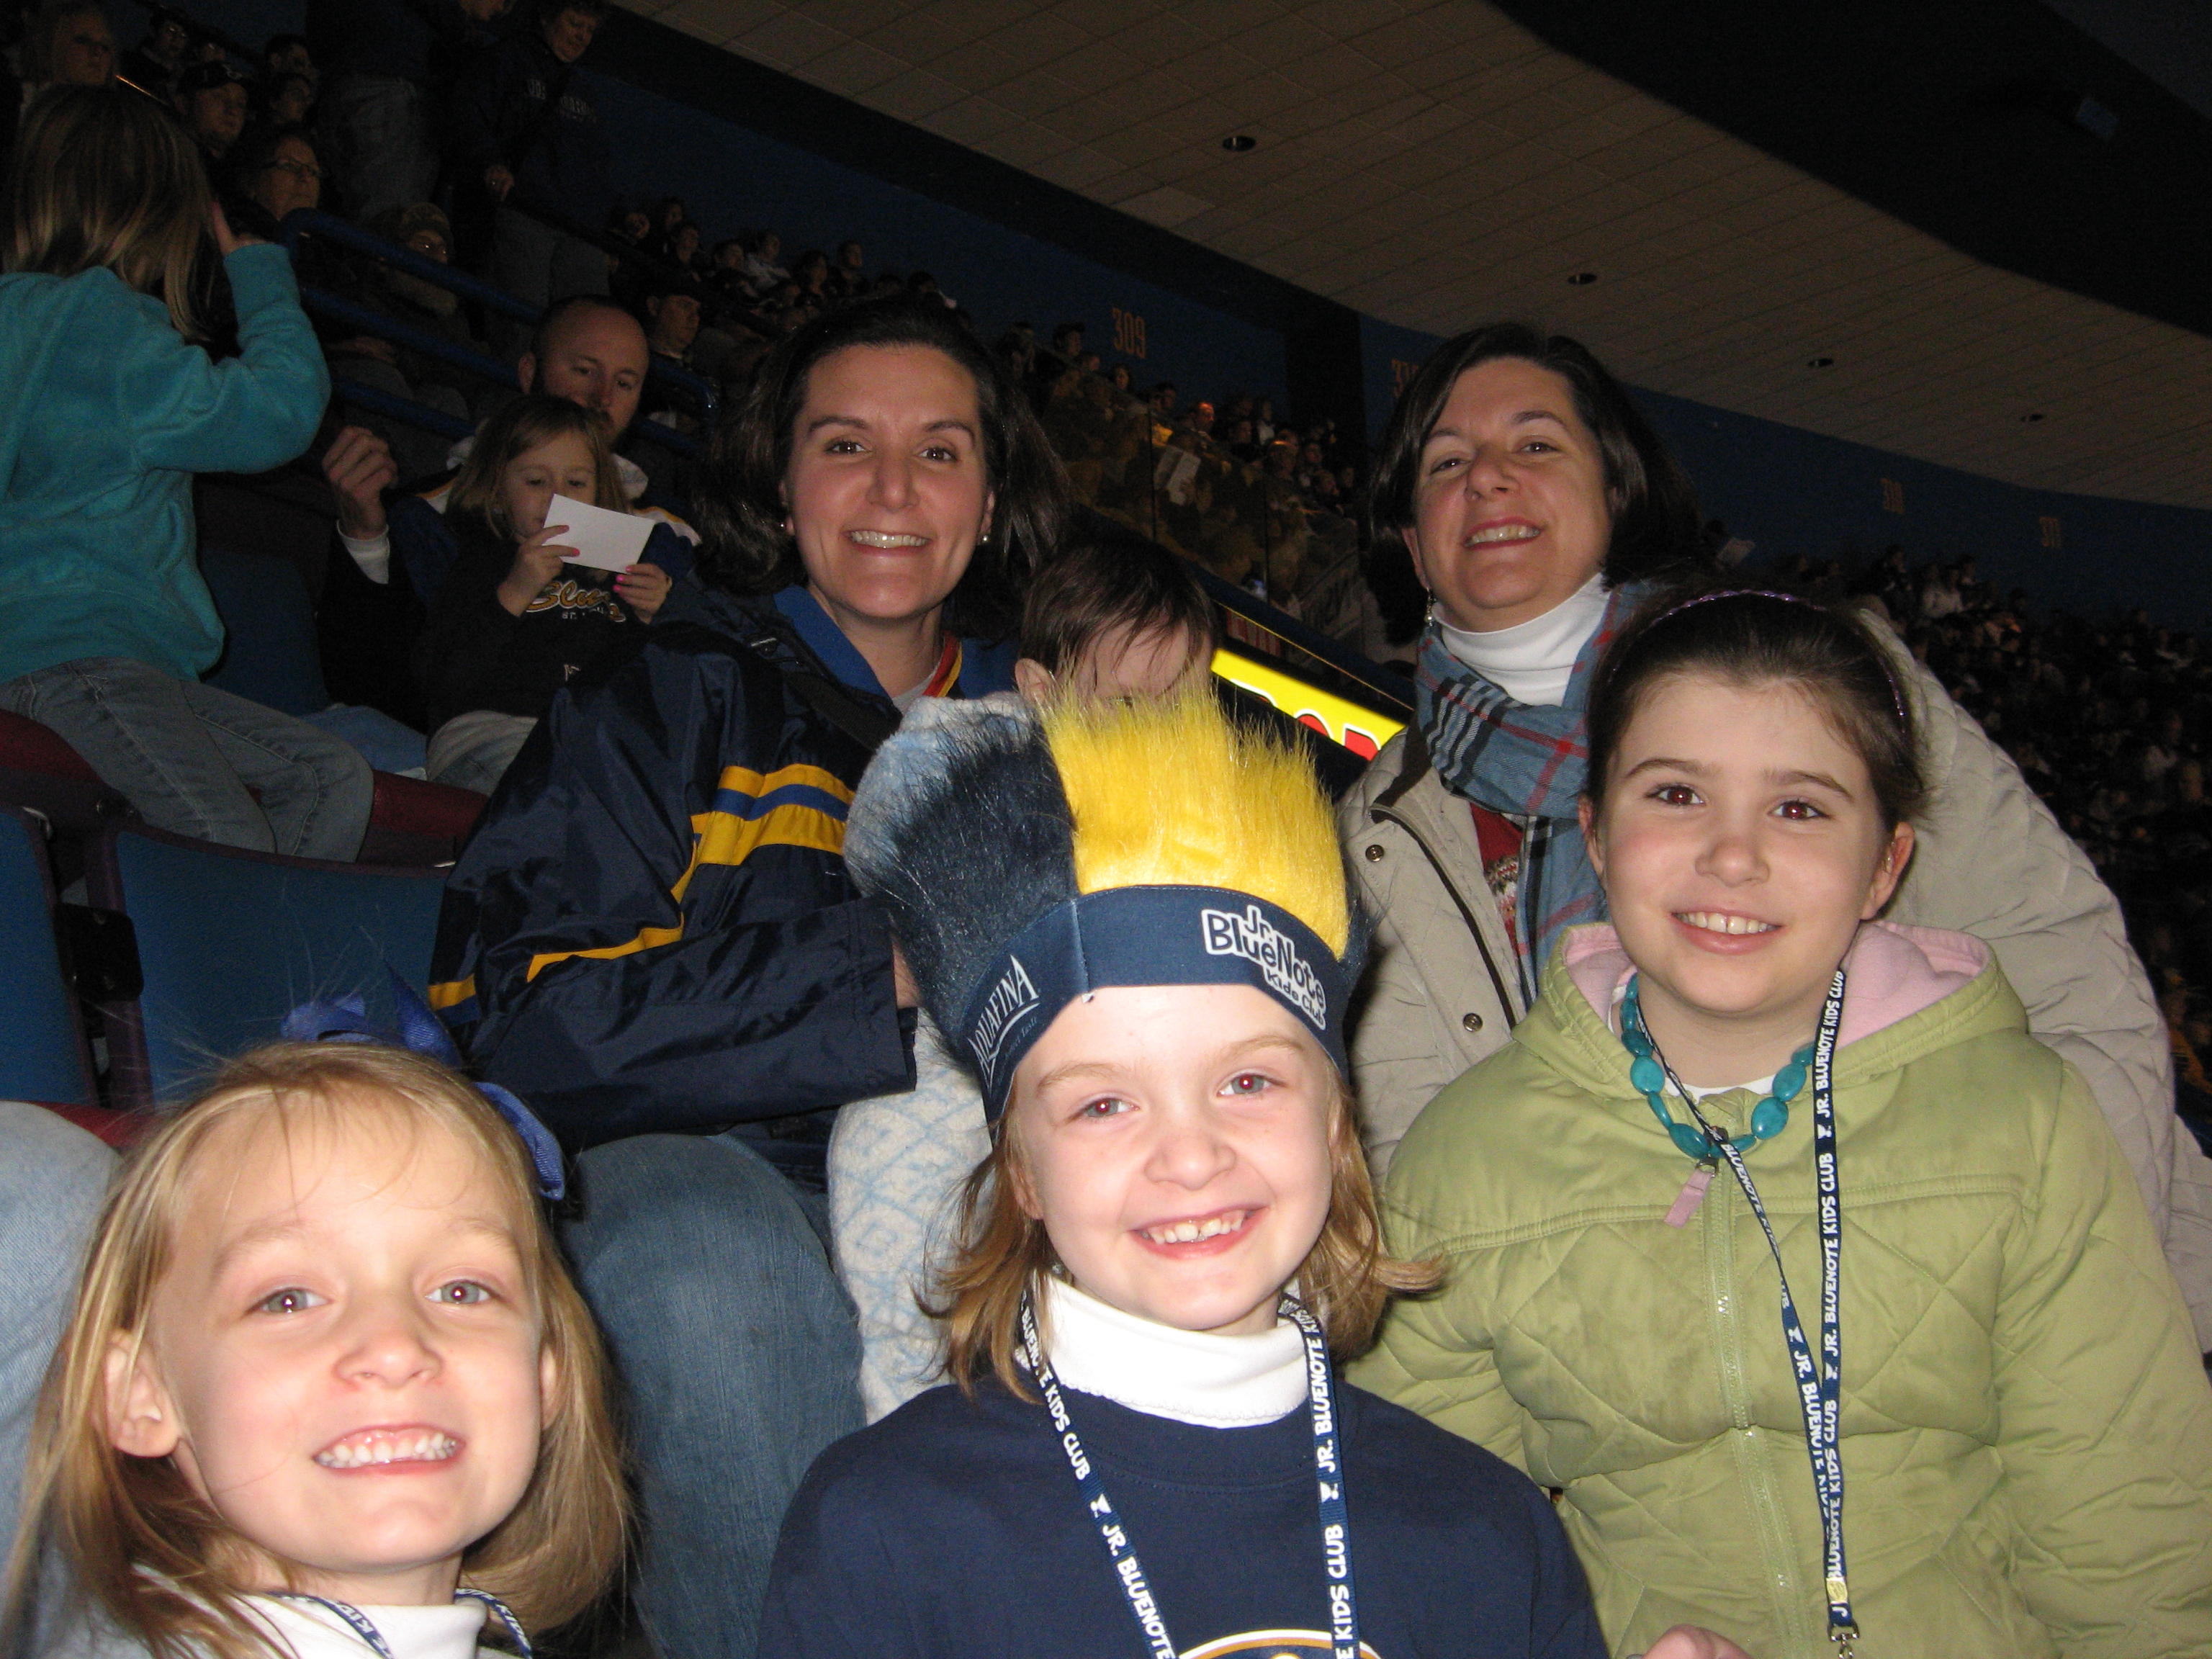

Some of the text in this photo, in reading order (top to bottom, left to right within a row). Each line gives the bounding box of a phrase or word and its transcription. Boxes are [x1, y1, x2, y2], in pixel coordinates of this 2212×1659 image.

[1111, 307, 1147, 359] 309
[1244, 908, 1274, 943] Jr.
[966, 954, 1040, 1090] AQUAFINA
[1267, 968, 1325, 1027] Kids Club
[1815, 970, 1844, 1118] JR. BLUENOTE KIDS CLUB
[1720, 1143, 1764, 1218] BLUENOTE
[1819, 1152, 1838, 1357] JR. BLUENOTE KIDS CLUB
[1306, 1337, 1333, 1436] BLUENOTE
[1794, 1349, 1812, 1379] JR.
[1044, 1384, 1071, 1432] KIDS
[1063, 1432, 1091, 1481] CLUB
[1823, 1399, 1837, 1444] CLUB
[1316, 1439, 1336, 1473] JR.
[1824, 1447, 1841, 1494] KIDS
[1324, 1524, 1347, 1579] CLUB
[1102, 1524, 1177, 1659] JR. BLUENOTE
[1330, 1584, 1354, 1641] KIDS
